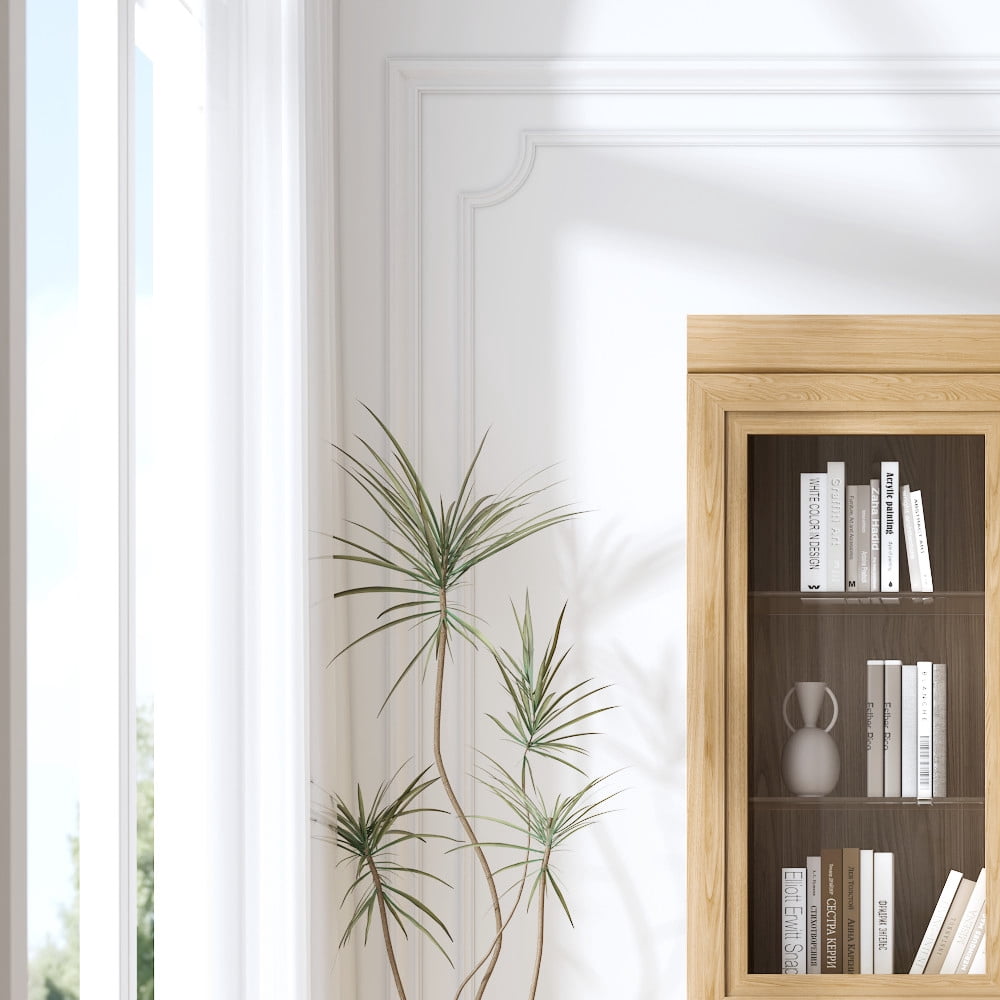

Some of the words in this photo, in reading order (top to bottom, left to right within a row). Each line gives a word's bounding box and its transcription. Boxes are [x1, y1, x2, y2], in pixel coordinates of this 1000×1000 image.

[809, 478, 820, 502] WHITE
[886, 472, 894, 499] Acrylic
[871, 487, 880, 515] Zaha
[809, 503, 820, 531] COLOR
[885, 501, 894, 535] painting
[809, 533, 820, 541] IN
[871, 518, 880, 550] Hadid
[809, 541, 820, 570] DESIGN
[785, 871, 803, 904] Elliott
[785, 906, 803, 940] Erwitt
[827, 898, 836, 935] СЕСТРА
[827, 938, 836, 968] КЕРРИ
